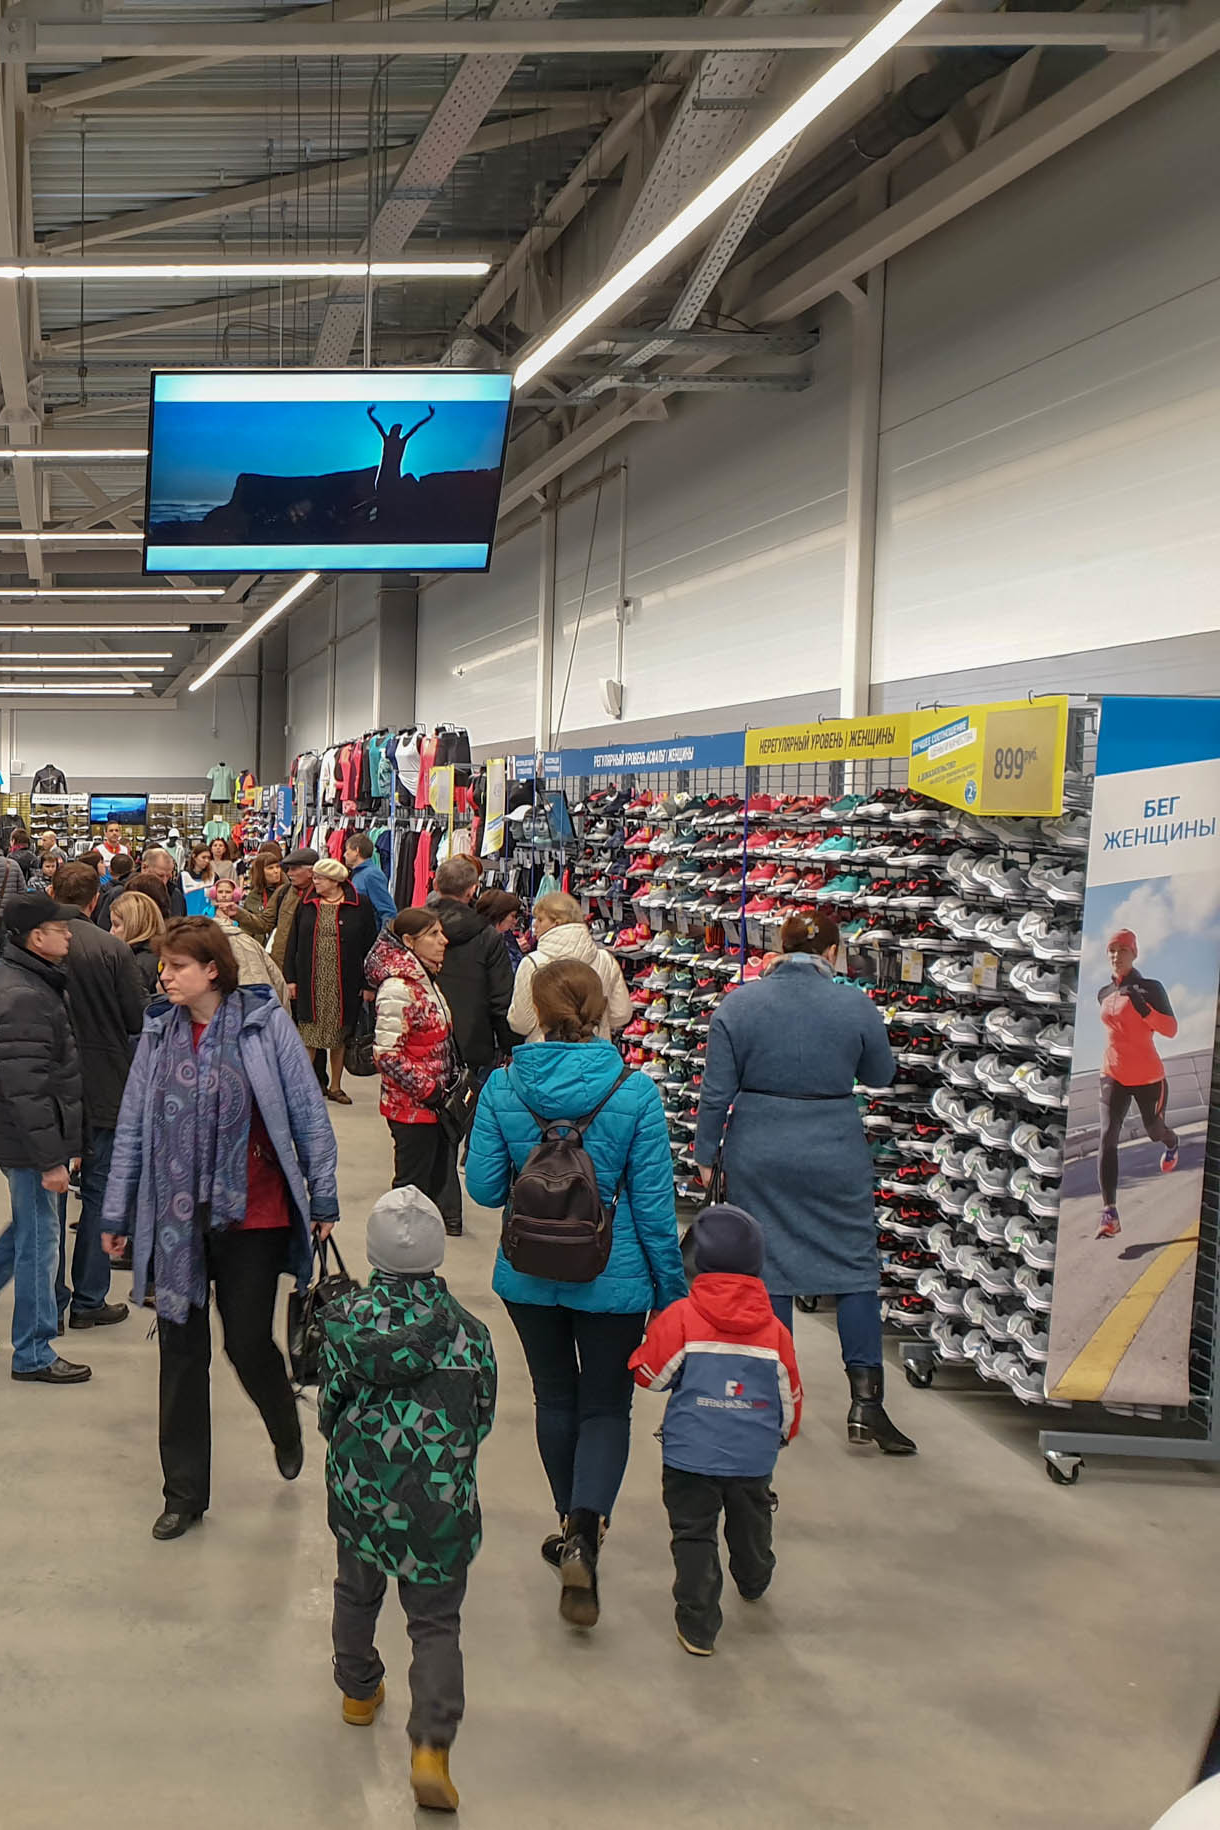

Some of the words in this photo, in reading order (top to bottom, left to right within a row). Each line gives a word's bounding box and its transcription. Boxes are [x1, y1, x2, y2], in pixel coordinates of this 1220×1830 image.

[759, 730, 809, 755] НЕРЕГУЛЯРНЫЙ
[810, 731, 844, 750] УРОВЕНЬ
[849, 726, 896, 749] ЖЕНЩИНЫ
[993, 747, 1024, 780] 899
[1143, 795, 1181, 819] БЕГ
[1103, 817, 1216, 851] ЖЕНЩИНЫ
